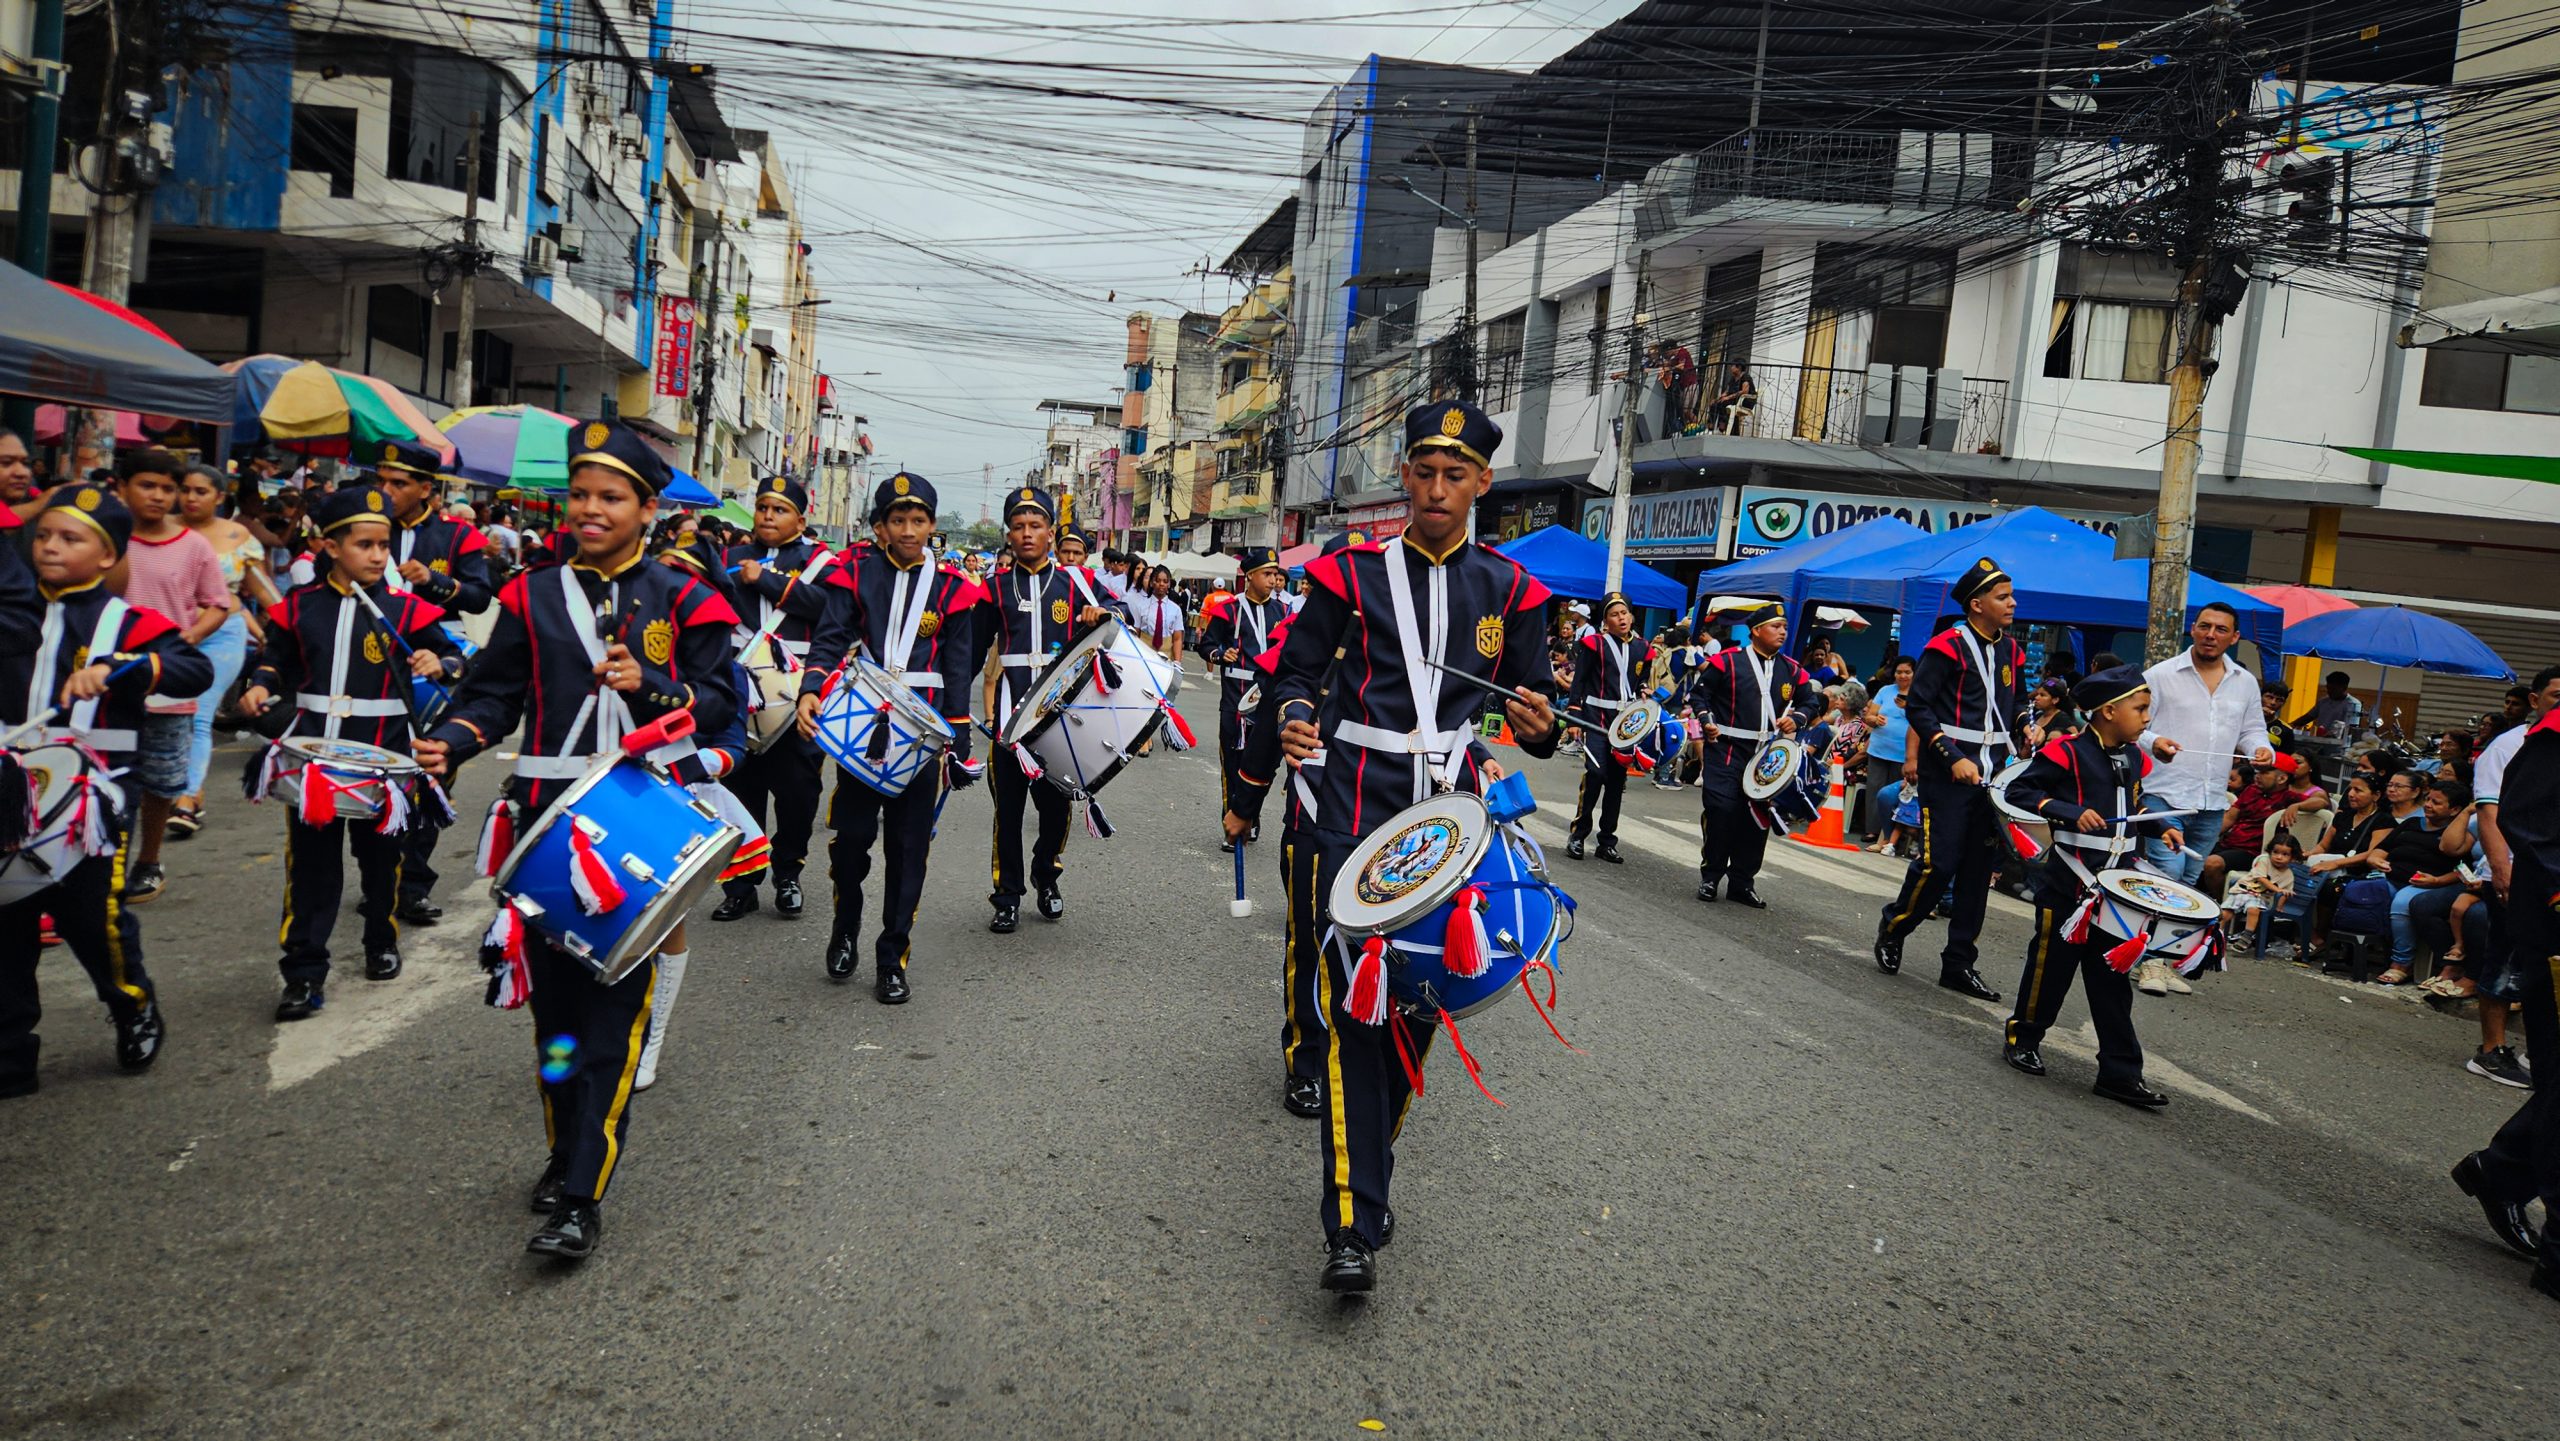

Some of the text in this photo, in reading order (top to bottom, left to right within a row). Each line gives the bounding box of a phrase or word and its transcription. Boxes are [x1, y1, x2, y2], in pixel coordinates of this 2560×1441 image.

[1533, 517, 1550, 527] BEAR
[1534, 505, 1557, 516] GOLDEN
[1604, 497, 1718, 540] OICA MEGALENS
[1813, 502, 1932, 539] OPA
[1479, 628, 1502, 653] SB
